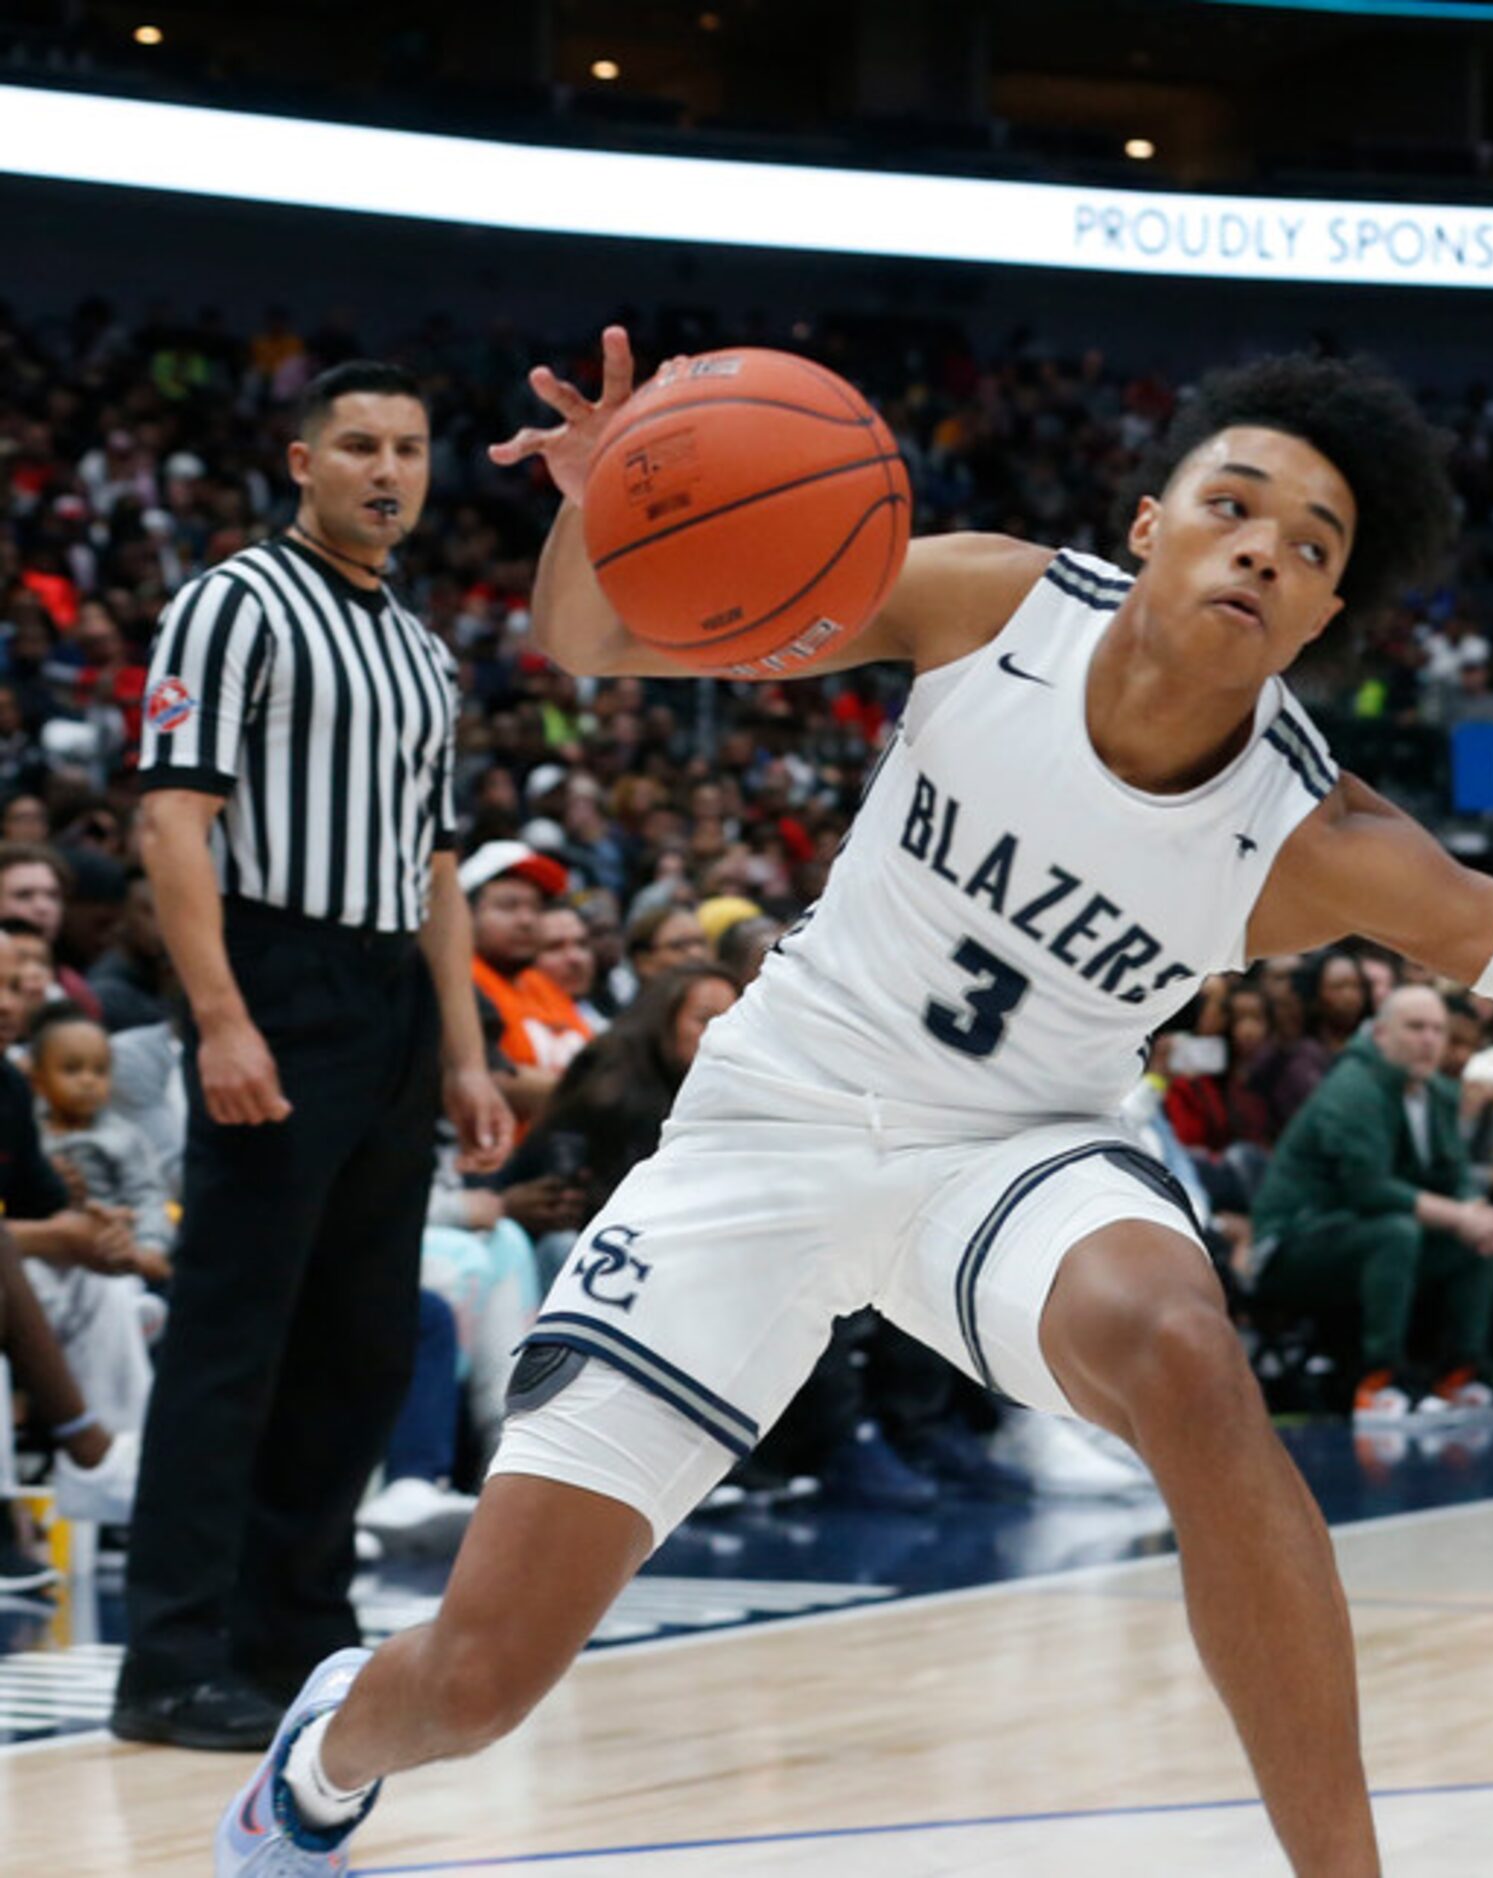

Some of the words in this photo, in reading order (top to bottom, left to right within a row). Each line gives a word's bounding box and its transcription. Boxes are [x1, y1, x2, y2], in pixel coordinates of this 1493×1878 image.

[1074, 203, 1303, 262] PROUDLY
[900, 772, 1196, 1004] BLAZERS
[922, 933, 1031, 1061] 3
[568, 1223, 653, 1316] SC
